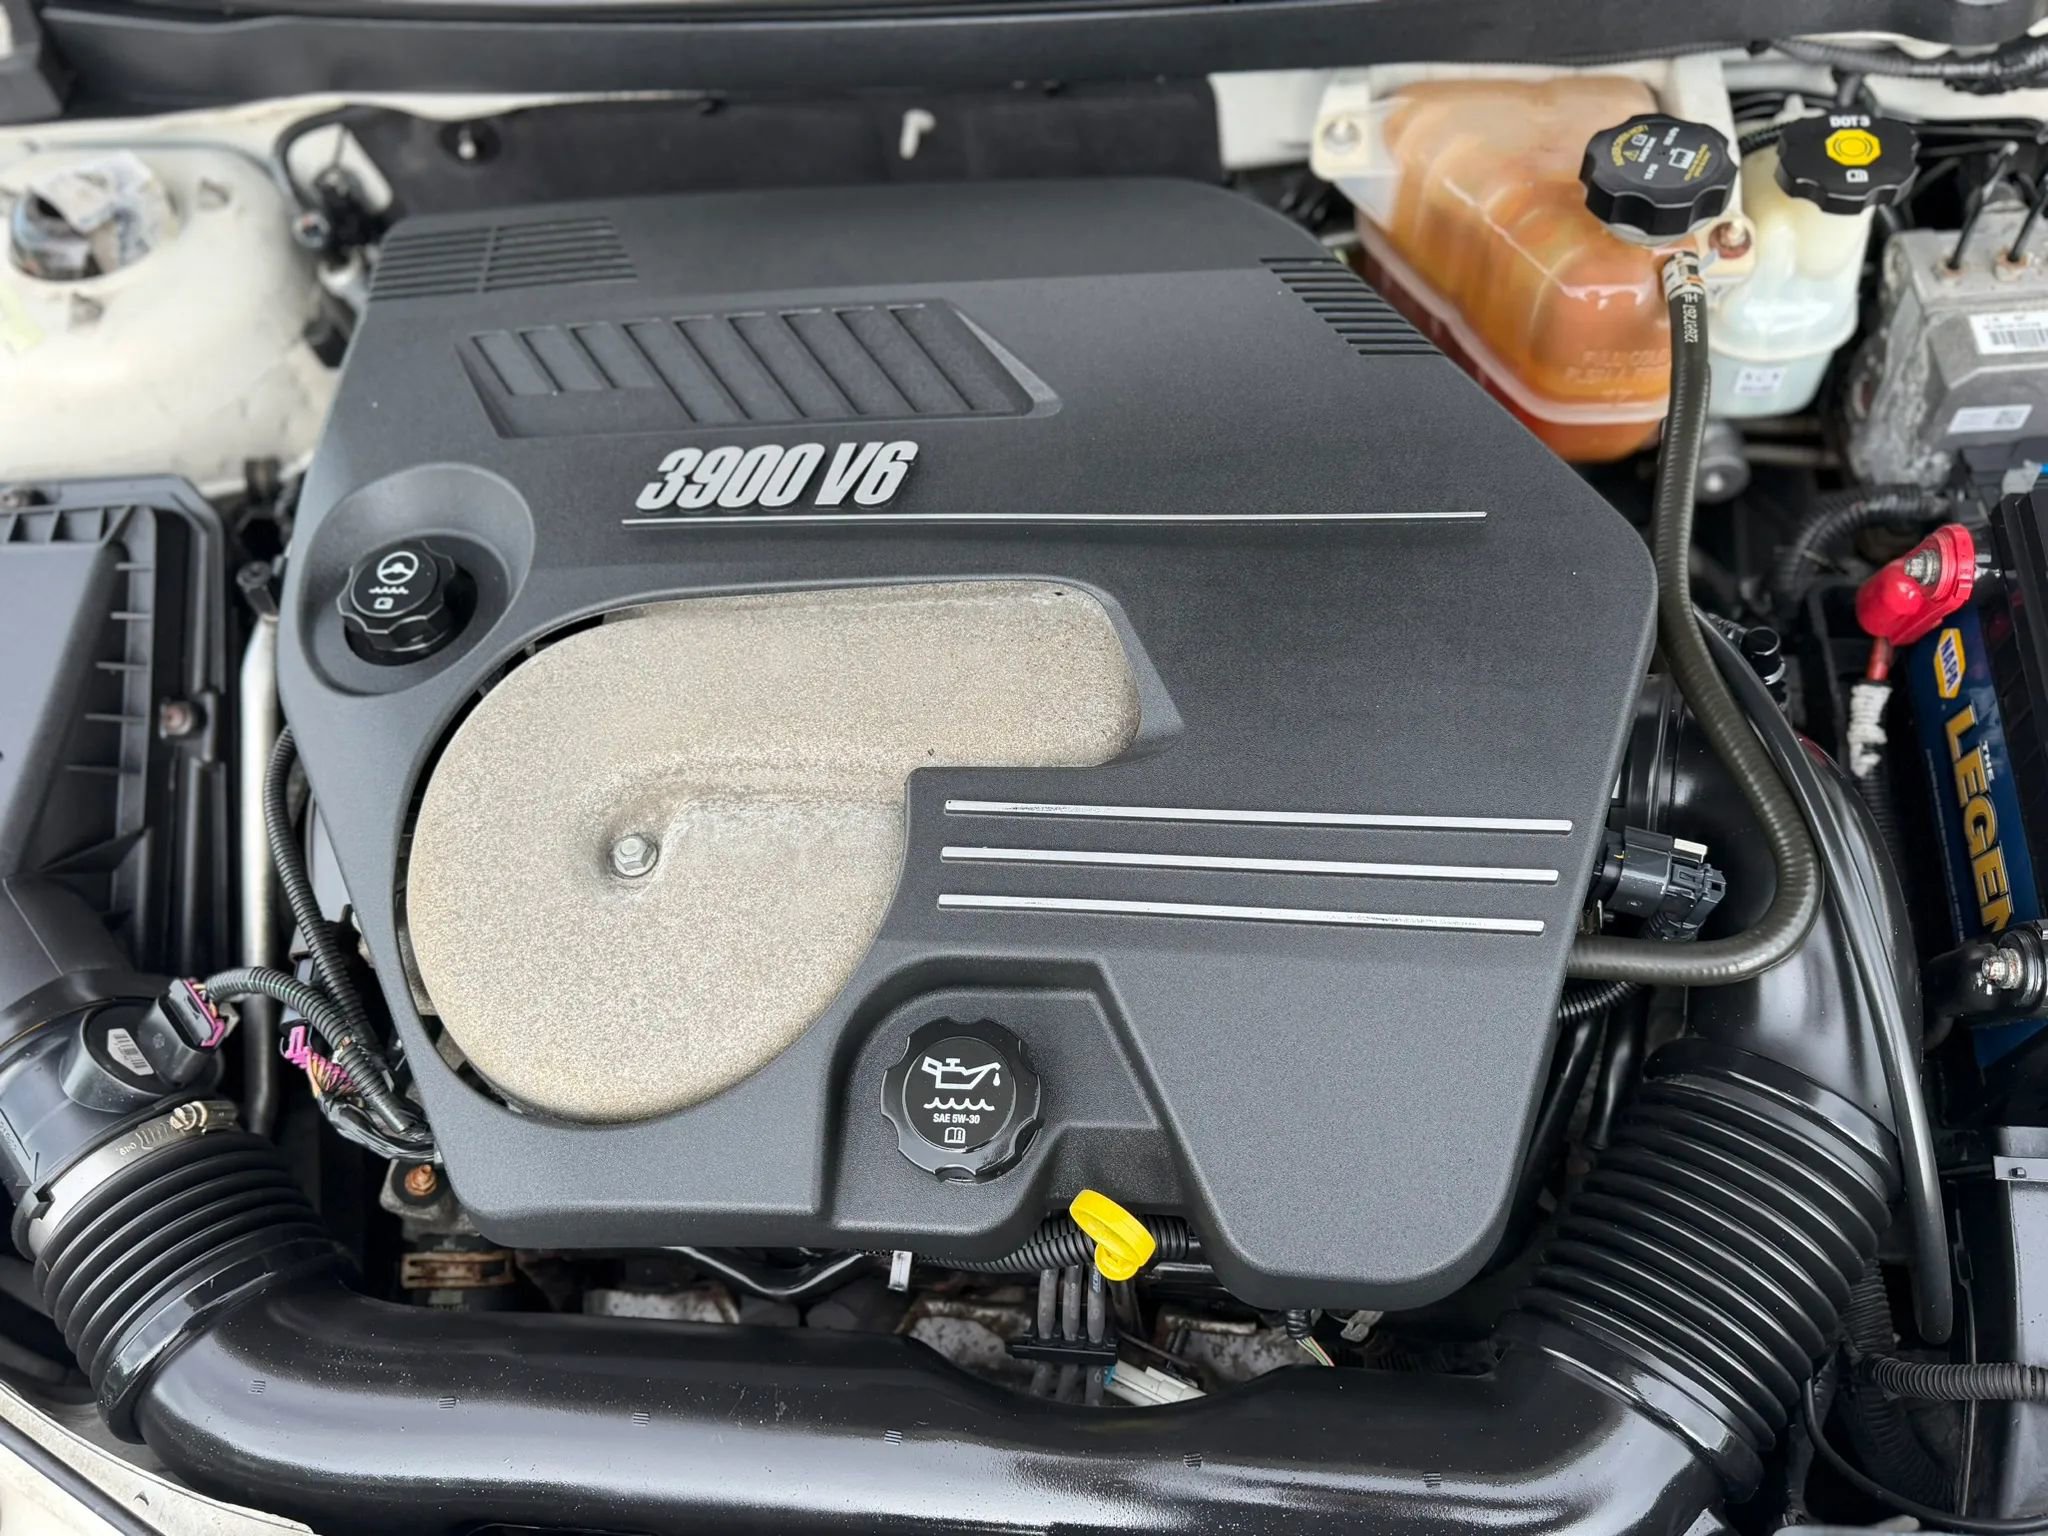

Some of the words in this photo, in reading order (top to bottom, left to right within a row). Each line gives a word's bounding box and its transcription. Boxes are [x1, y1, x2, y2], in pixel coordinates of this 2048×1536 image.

[1829, 115, 1858, 128] DOT
[1860, 115, 1870, 127] 3
[635, 443, 825, 510] 3900
[815, 441, 919, 506] V6
[1939, 635, 1960, 690] NAPA
[1980, 740, 1995, 782] THE
[933, 1112, 951, 1123] SAE
[952, 1113, 980, 1124] 5W-30
